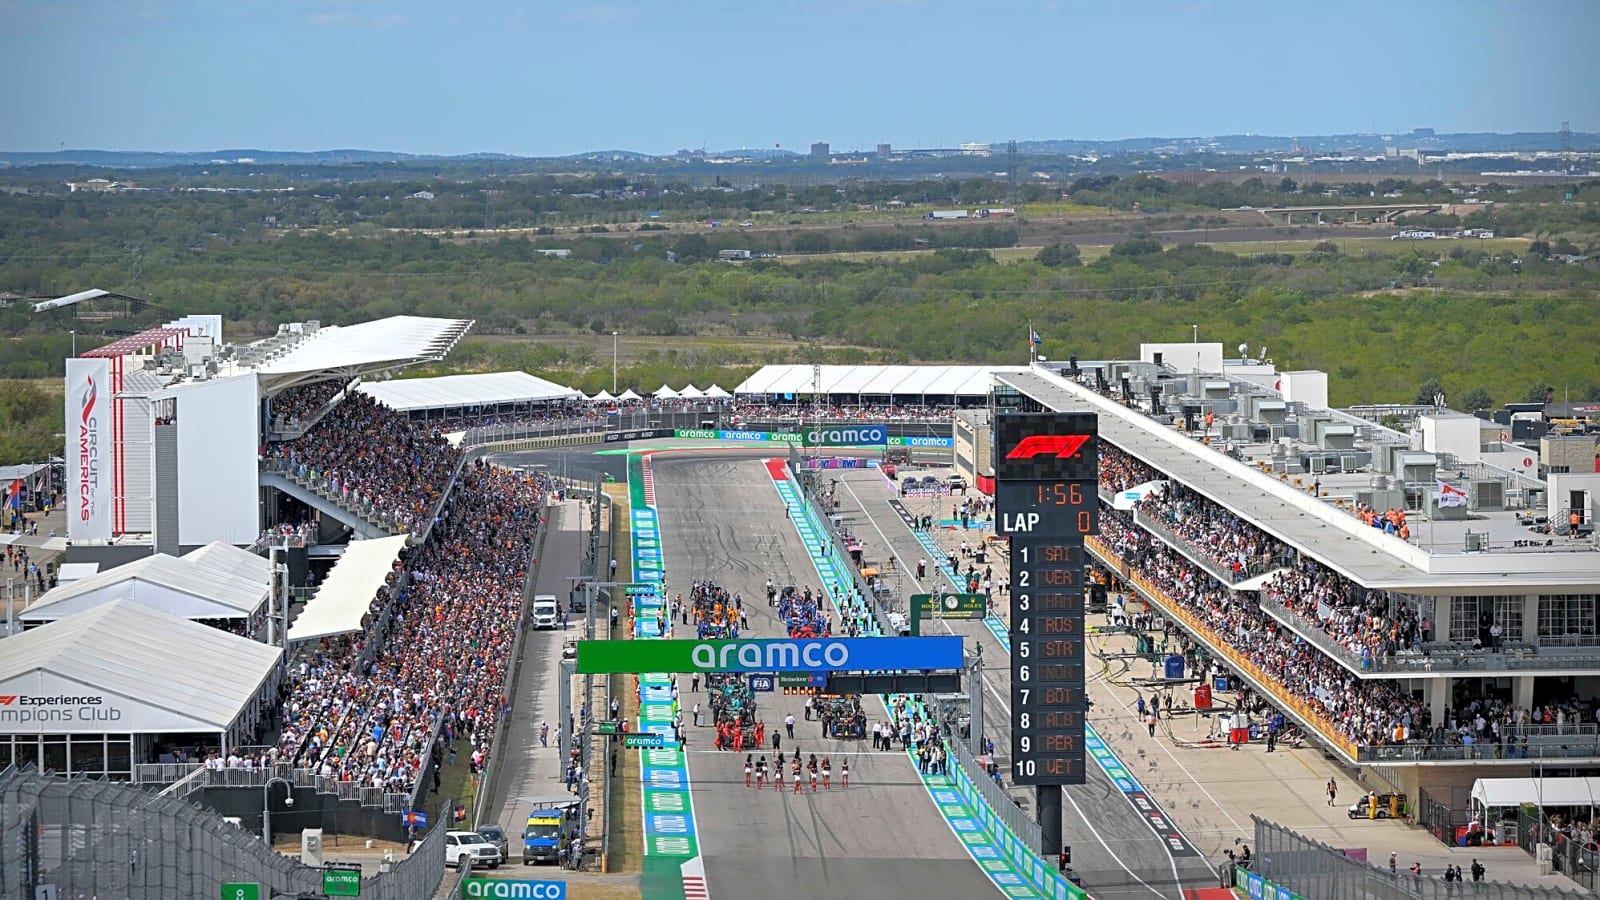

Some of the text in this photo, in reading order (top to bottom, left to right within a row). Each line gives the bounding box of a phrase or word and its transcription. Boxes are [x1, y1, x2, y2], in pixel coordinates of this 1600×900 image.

[679, 430, 715, 438] aramco
[725, 432, 761, 440] aramco
[806, 429, 882, 443] aramco
[911, 437, 948, 447] aramco
[88, 417, 98, 488] CIRCUIT
[1005, 435, 1091, 458] F1
[842, 459, 857, 468] BWT
[80, 425, 89, 521] AMERICAS
[1038, 484, 1082, 505] 1:56
[1003, 511, 1090, 532] LAP 0
[1020, 547, 1070, 563] 1 SAI
[1020, 571, 1072, 586] 2 VER
[1020, 595, 1029, 610] 3
[1020, 618, 1072, 634] 4 RUS
[691, 642, 849, 668] aramco
[1020, 642, 1072, 657] 5 STR
[1020, 665, 1030, 681] 6
[19, 695, 103, 706] Experiences
[1020, 689, 1071, 705] 7 BOT
[1, 707, 121, 724] mpions Club
[1021, 713, 1072, 728] 8 ALB
[1021, 736, 1073, 752] 9 PER
[1016, 760, 1072, 776] 10 VET
[467, 881, 560, 899] aramco
